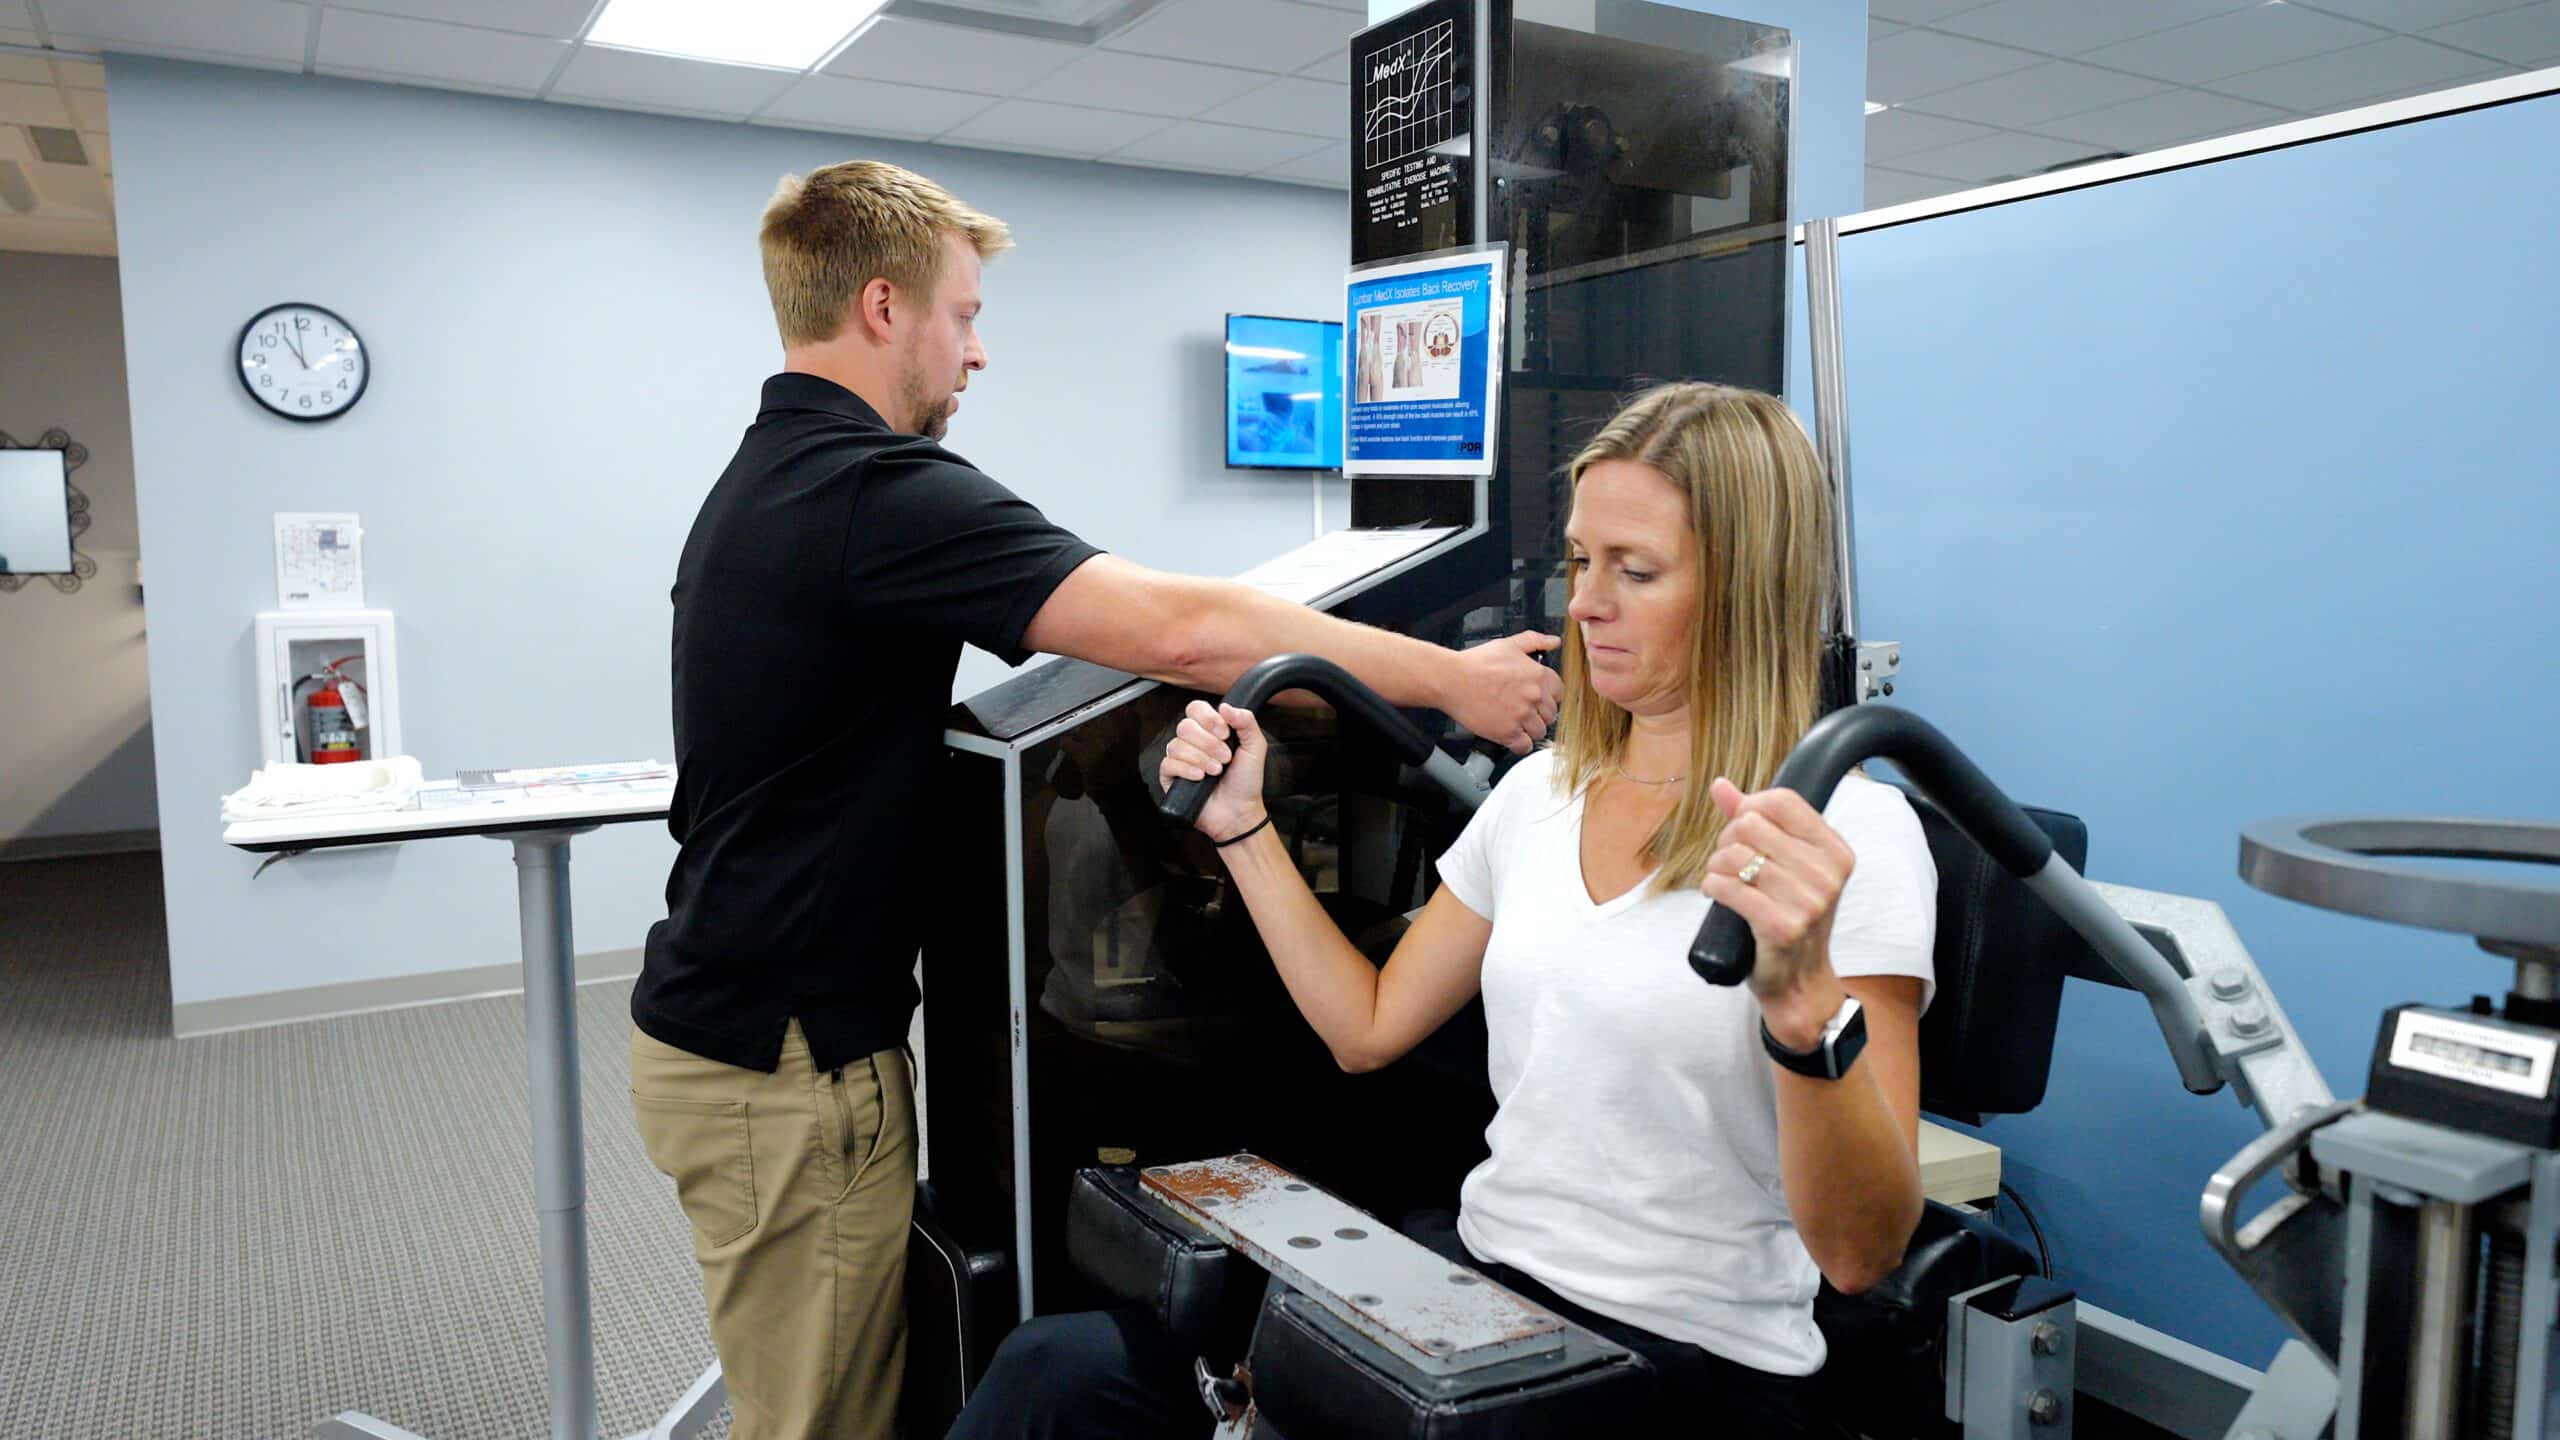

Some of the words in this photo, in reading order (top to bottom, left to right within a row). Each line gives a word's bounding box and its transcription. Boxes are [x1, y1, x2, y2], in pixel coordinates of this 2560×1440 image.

[1373, 54, 1406, 83] MedX
[1381, 167, 1402, 181] SPECIFIC
[1404, 159, 1424, 173] TESTING
[1426, 155, 1437, 166] AND
[1367, 179, 1402, 198] REHABILITATIVE
[1404, 171, 1427, 186] EXERCISE
[1431, 163, 1452, 177] MACHINE
[1394, 286, 1421, 299] Isolates
[1422, 282, 1440, 296] Back
[1441, 279, 1479, 294] Recovery
[274, 321, 287, 335] 11
[259, 334, 278, 348] 10
[334, 338, 346, 352] 2
[252, 353, 267, 368] 9
[343, 358, 355, 372] 3
[260, 374, 273, 388] 8
[336, 377, 349, 391] 4
[280, 388, 289, 401] 7
[321, 391, 334, 404] 5
[299, 395, 313, 409] 6
